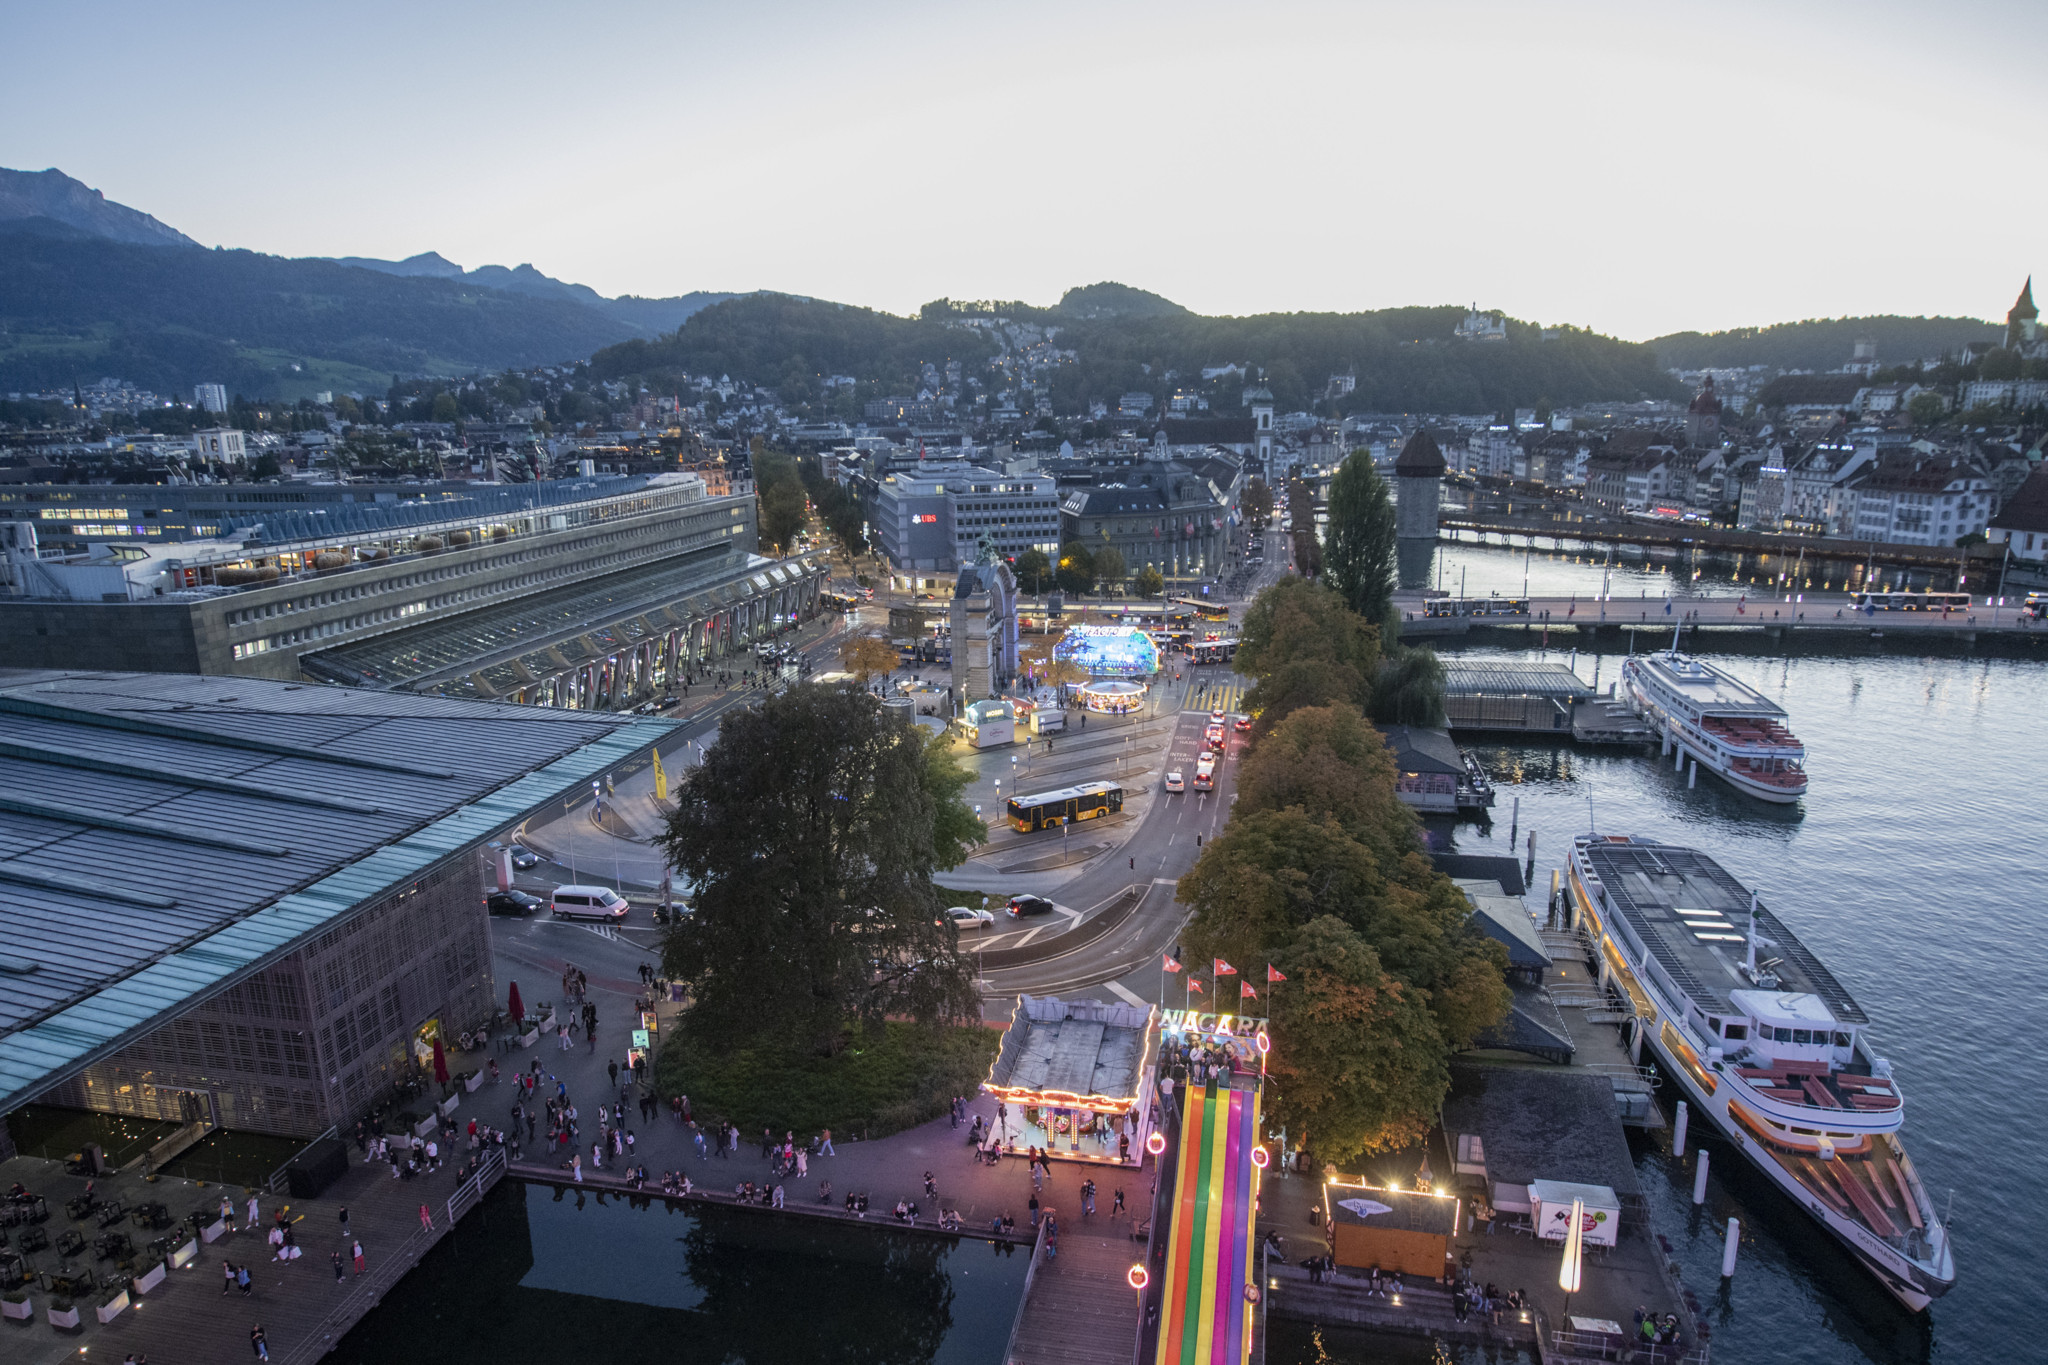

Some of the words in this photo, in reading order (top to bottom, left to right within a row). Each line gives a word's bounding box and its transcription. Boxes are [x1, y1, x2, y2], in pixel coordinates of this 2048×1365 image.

[921, 514, 937, 523] UBS
[1158, 1008, 1269, 1037] NIAGARA
[1857, 1232, 1900, 1266] GOTTHARD
